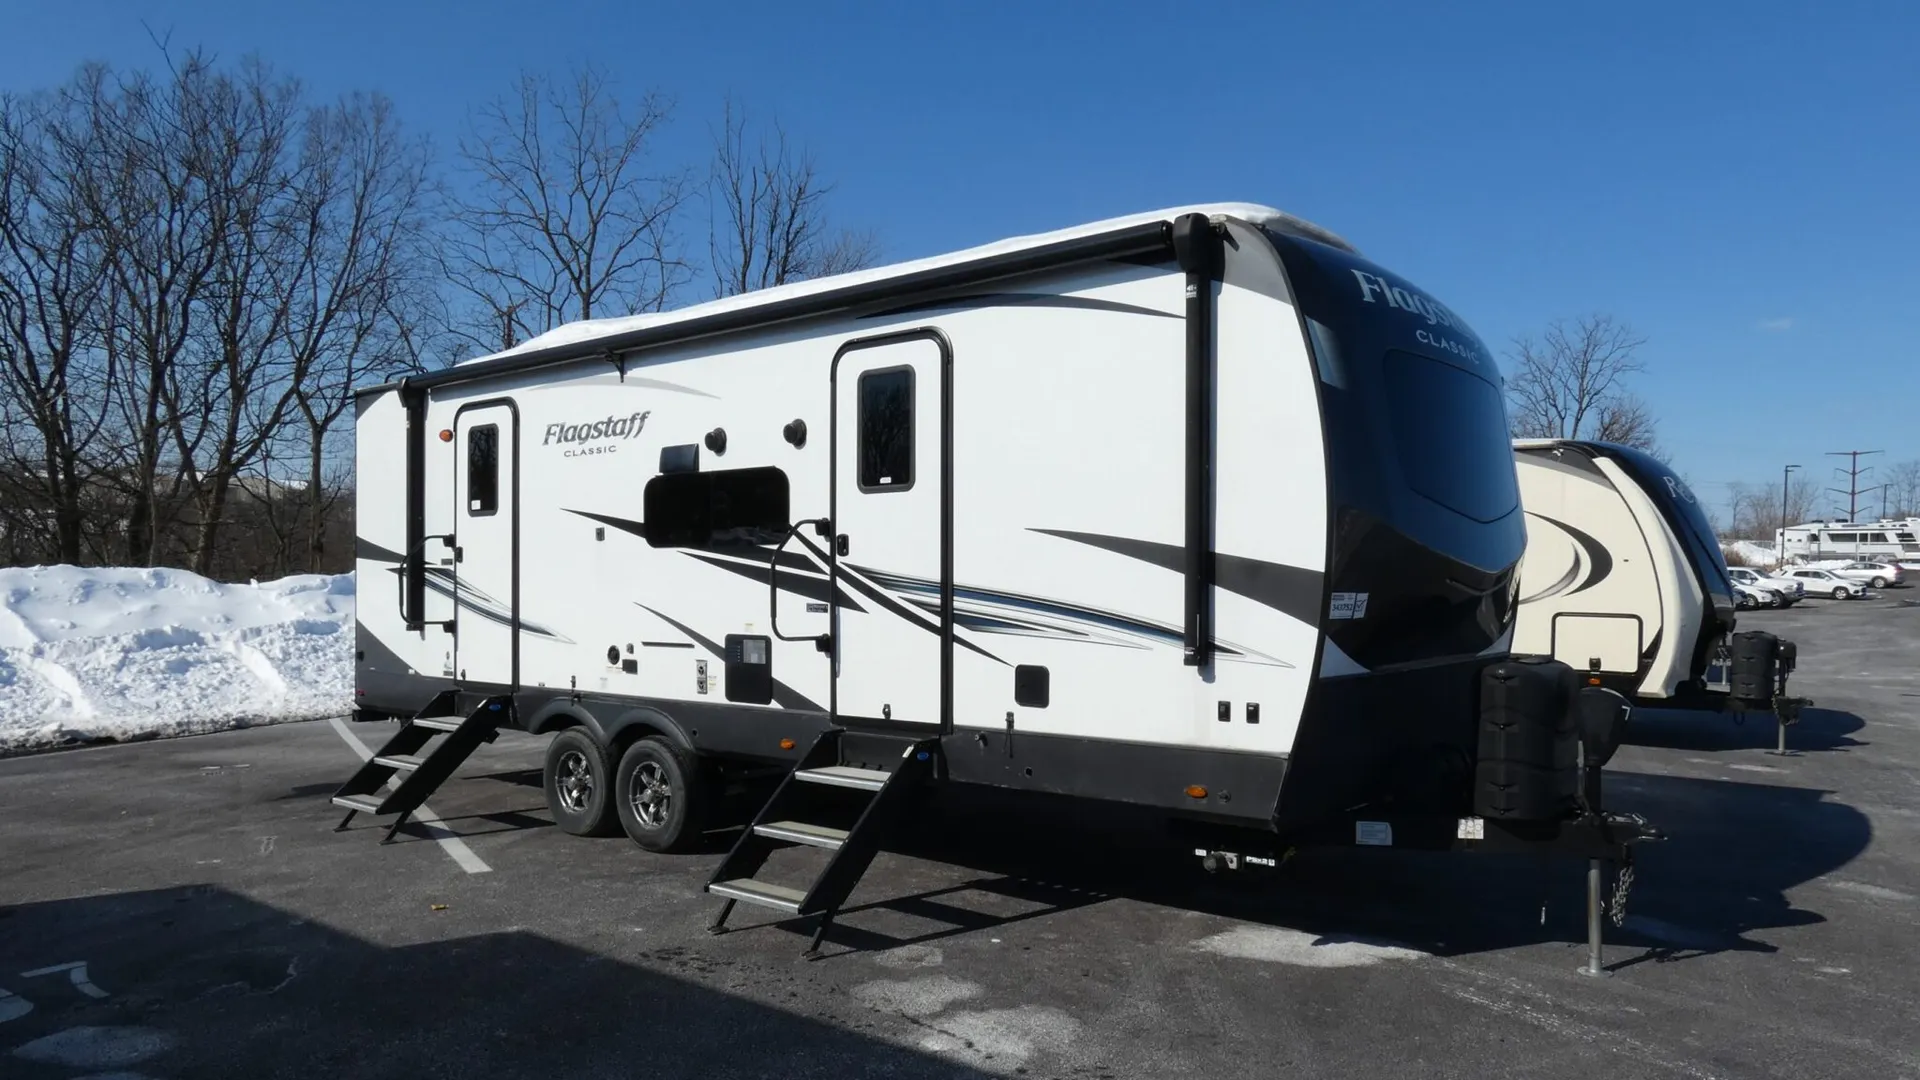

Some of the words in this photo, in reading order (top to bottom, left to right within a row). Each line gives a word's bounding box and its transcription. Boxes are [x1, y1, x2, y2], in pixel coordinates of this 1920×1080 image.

[1350, 269, 1479, 347] Flagst
[1416, 329, 1480, 365] CLASSIC
[542, 411, 652, 445] Flagstaff
[563, 445, 617, 458] CLASSIC
